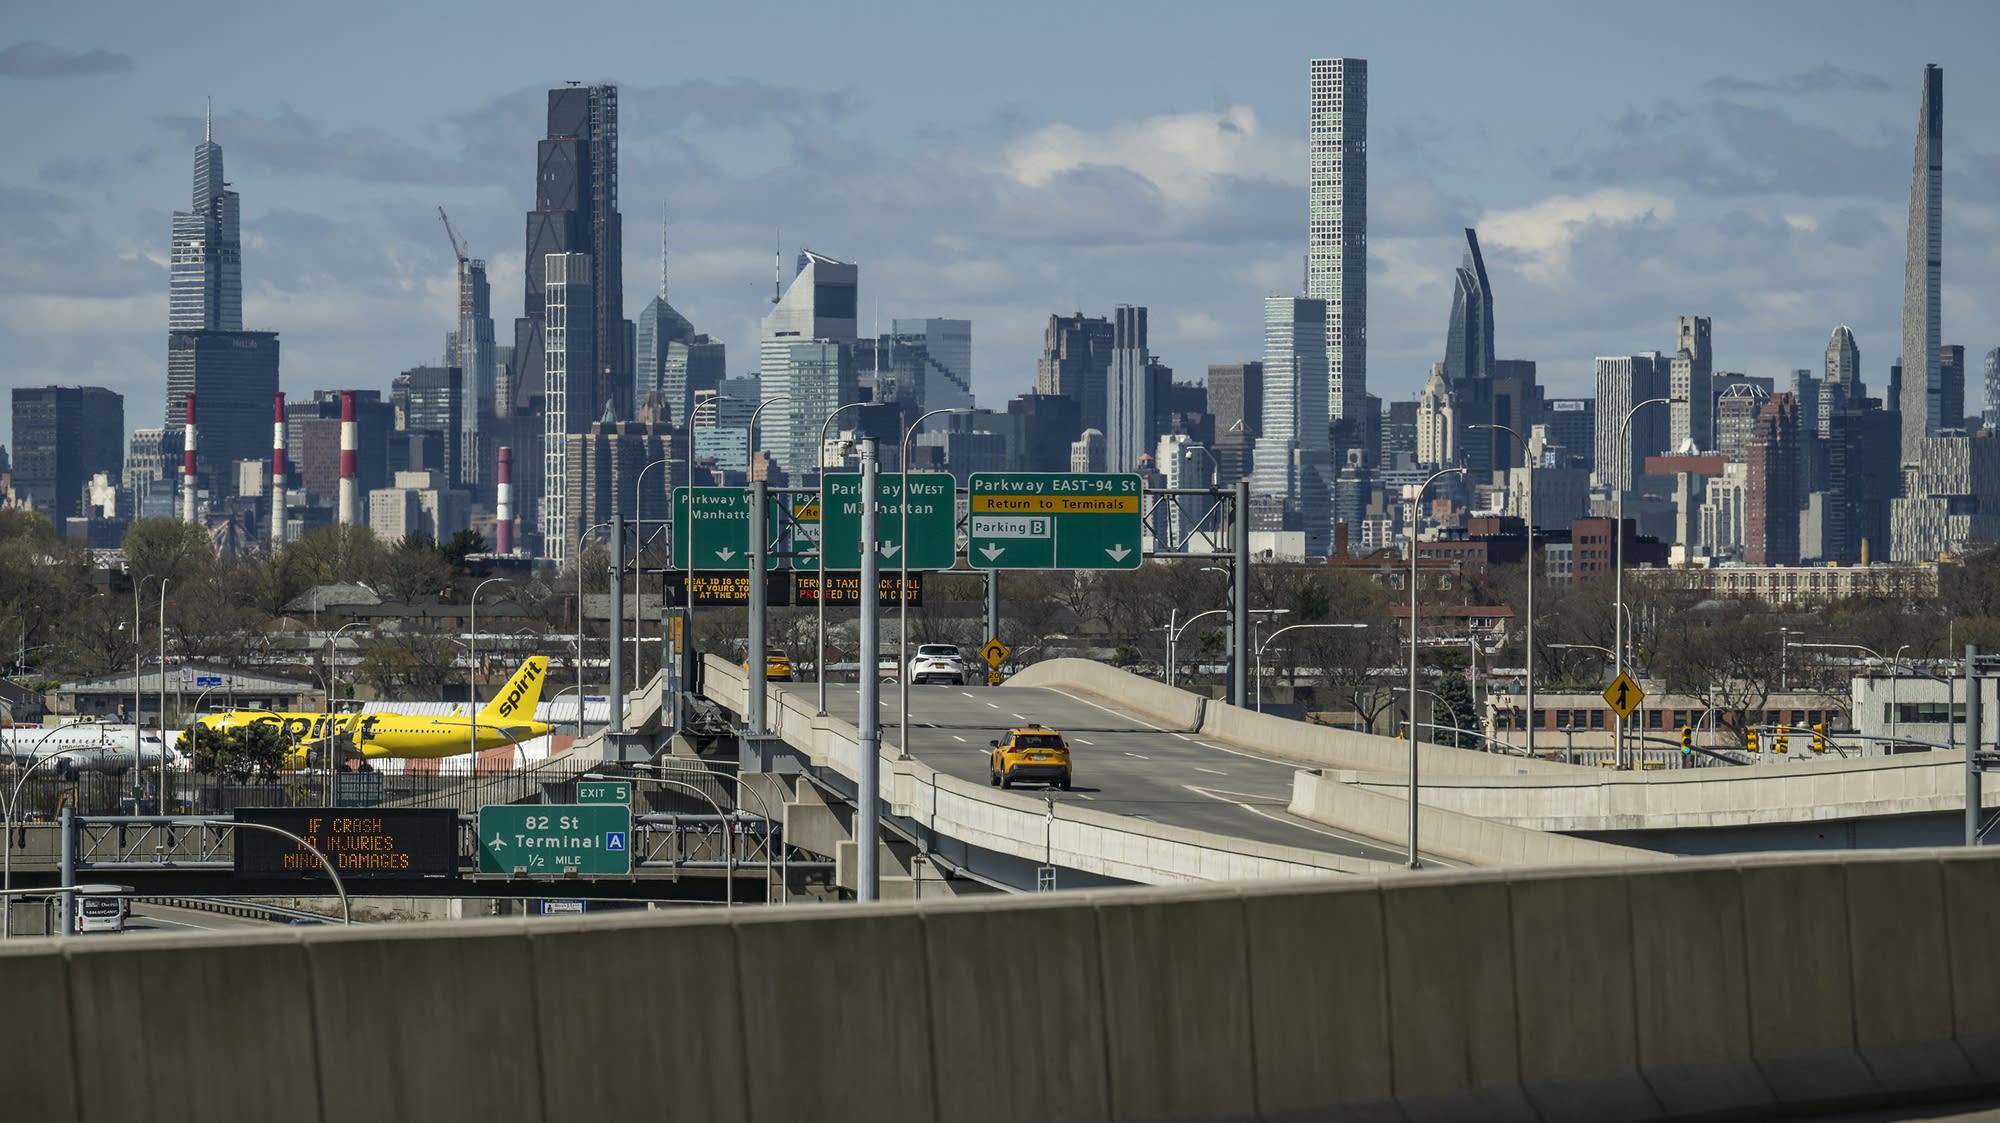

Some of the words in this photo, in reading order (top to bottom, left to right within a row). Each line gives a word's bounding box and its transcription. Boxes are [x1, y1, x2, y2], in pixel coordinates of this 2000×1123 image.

[831, 483, 900, 497] Parkay
[909, 483, 945, 495] WEST
[975, 480, 1044, 494] Parkway
[1052, 480, 1113, 491] EAST-94
[1121, 480, 1137, 491] St
[987, 499, 1031, 509] Return
[1040, 500, 1053, 509] to
[1062, 499, 1124, 510] Terminals
[692, 510, 750, 519] Manhatta
[975, 522, 1026, 534] Parking
[1033, 522, 1043, 534] B
[836, 579, 859, 588] TAXI
[896, 579, 920, 588] FLL
[800, 590, 843, 600] PROEED
[847, 590, 859, 600] TO
[500, 661, 542, 717] spirit
[580, 788, 605, 798] EXIT
[616, 787, 626, 800] 5
[309, 818, 323, 833] IF
[333, 818, 382, 833] CRASH
[525, 816, 549, 830] 82
[560, 816, 580, 830] St
[327, 836, 393, 850] INJURIES
[515, 834, 600, 849] Terminal
[609, 835, 622, 848] A
[338, 853, 409, 869] DAMAGES
[555, 855, 582, 865] MILE
